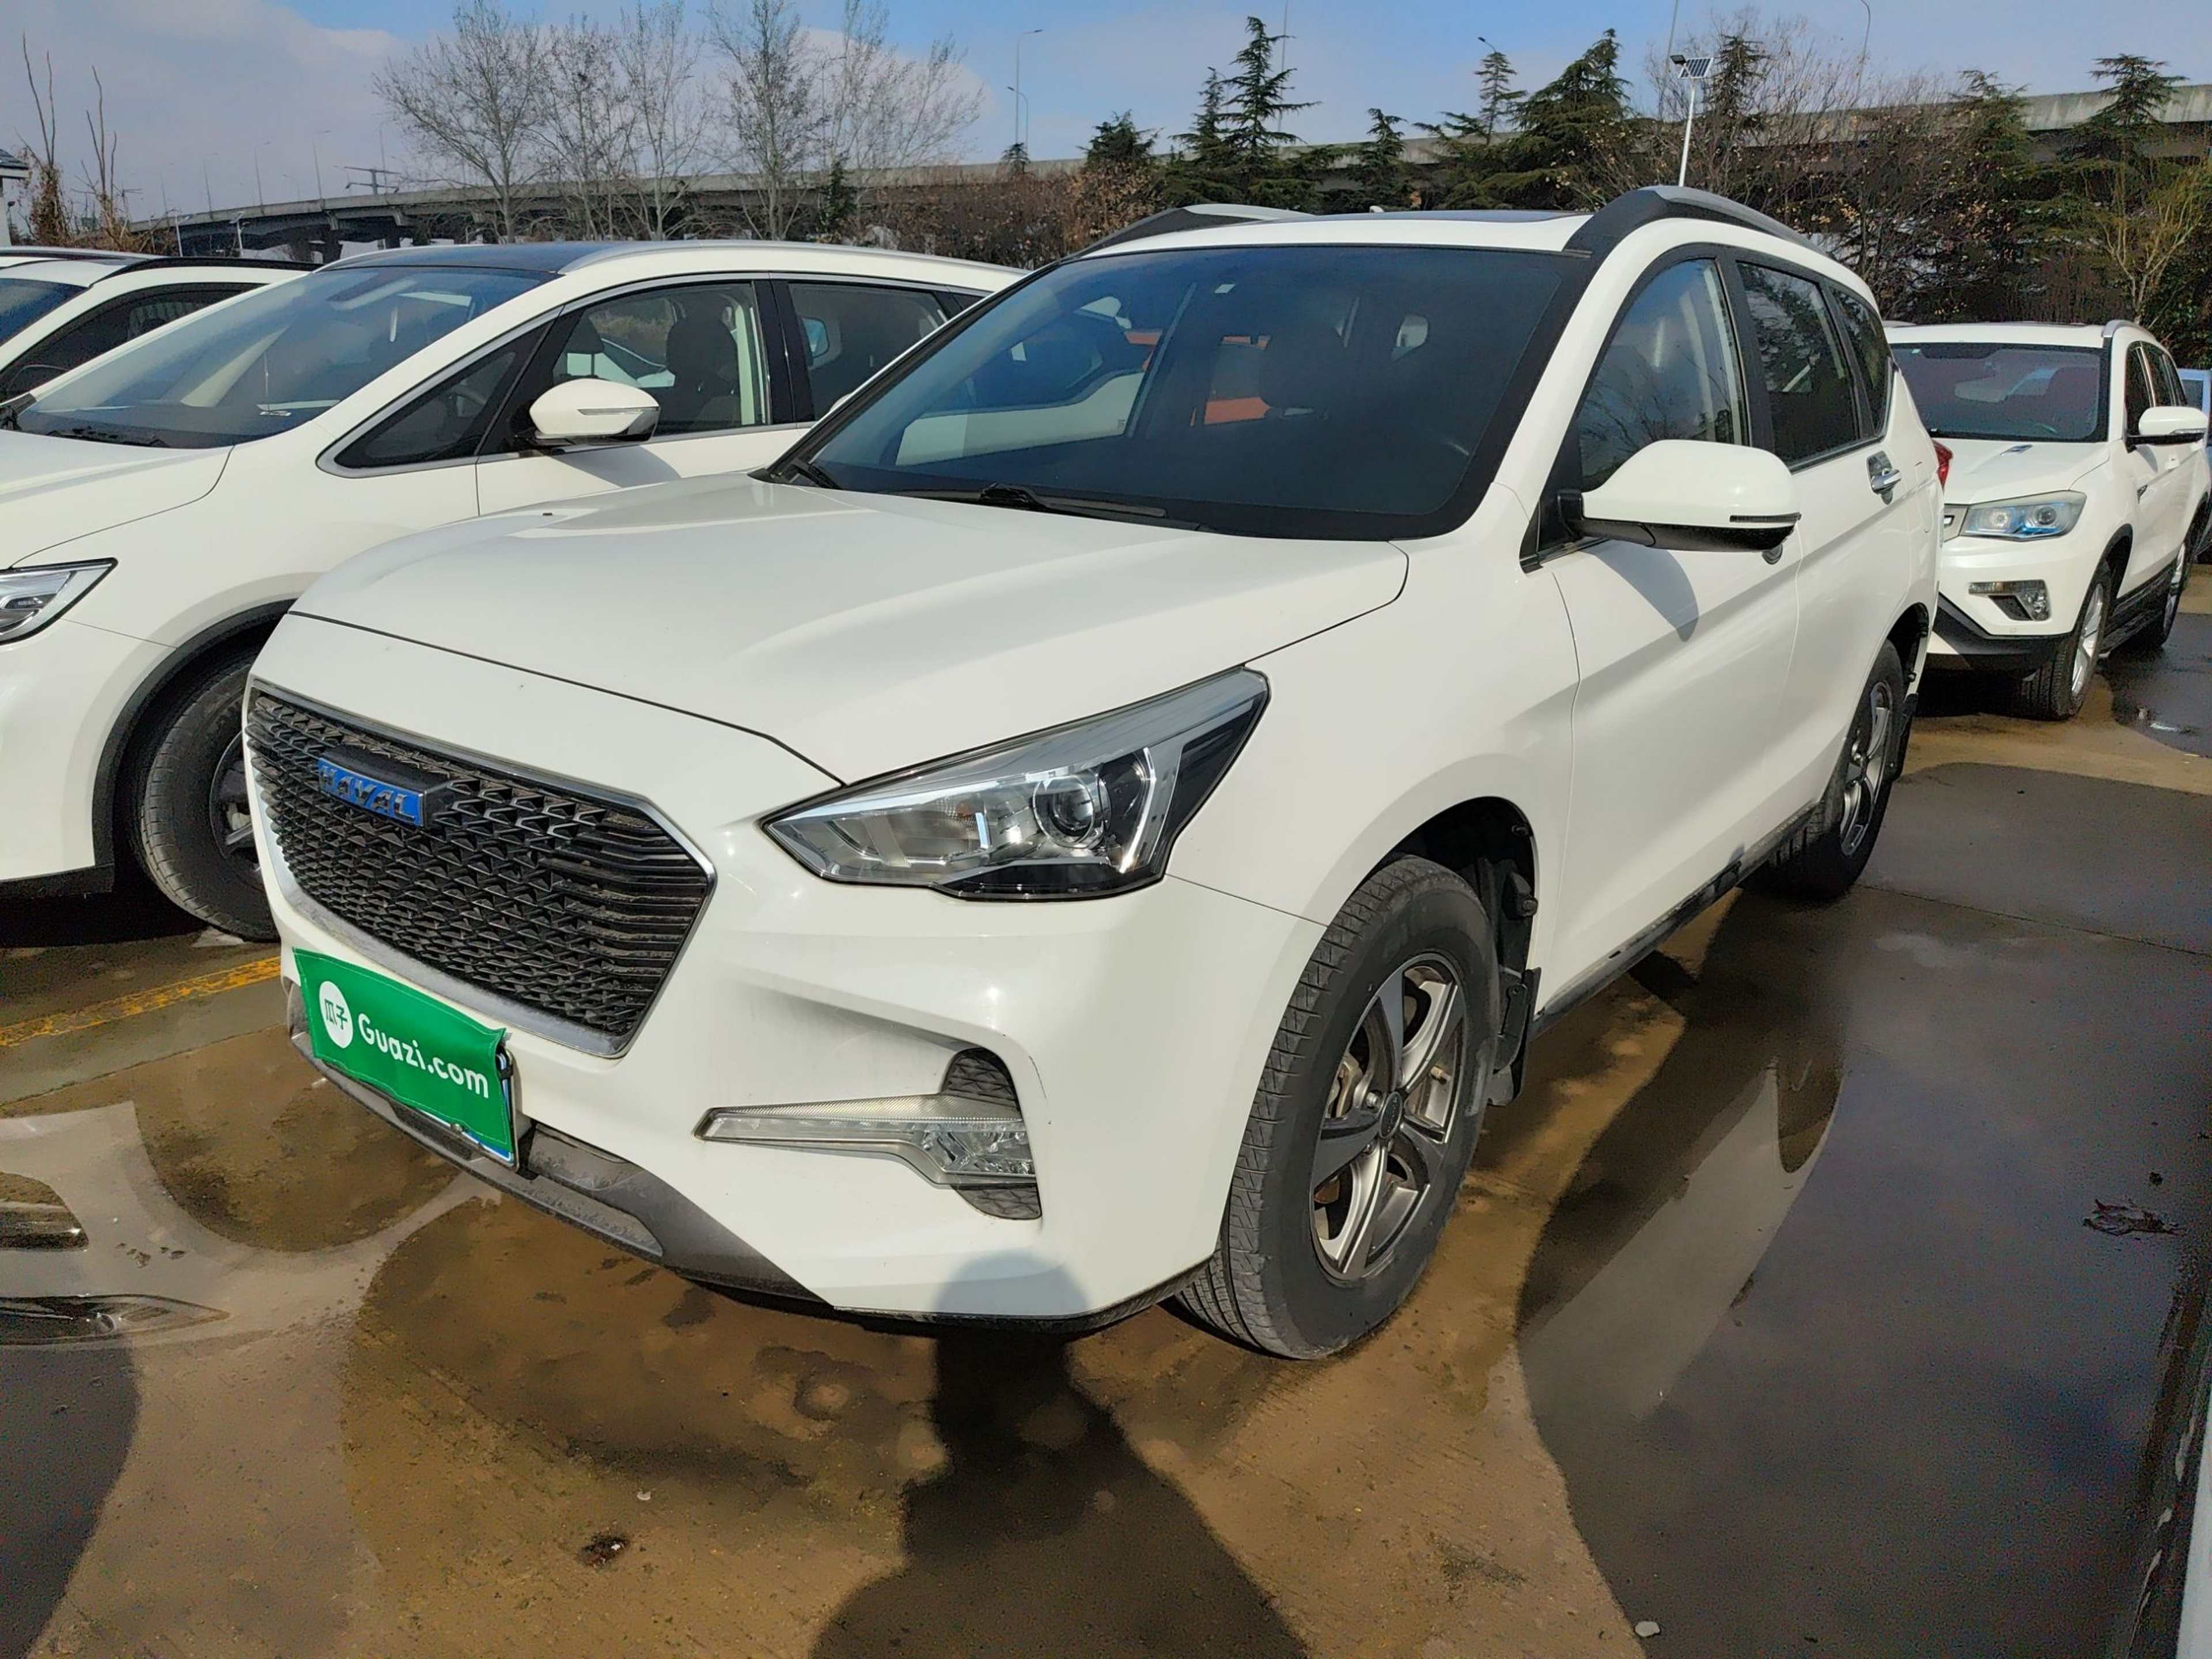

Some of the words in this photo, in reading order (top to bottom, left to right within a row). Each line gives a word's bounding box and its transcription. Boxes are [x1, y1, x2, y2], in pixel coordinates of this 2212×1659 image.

[319, 766, 415, 821] HAVAL
[324, 998, 348, 1030] 瓜子
[358, 1013, 489, 1099] Guazi.com
